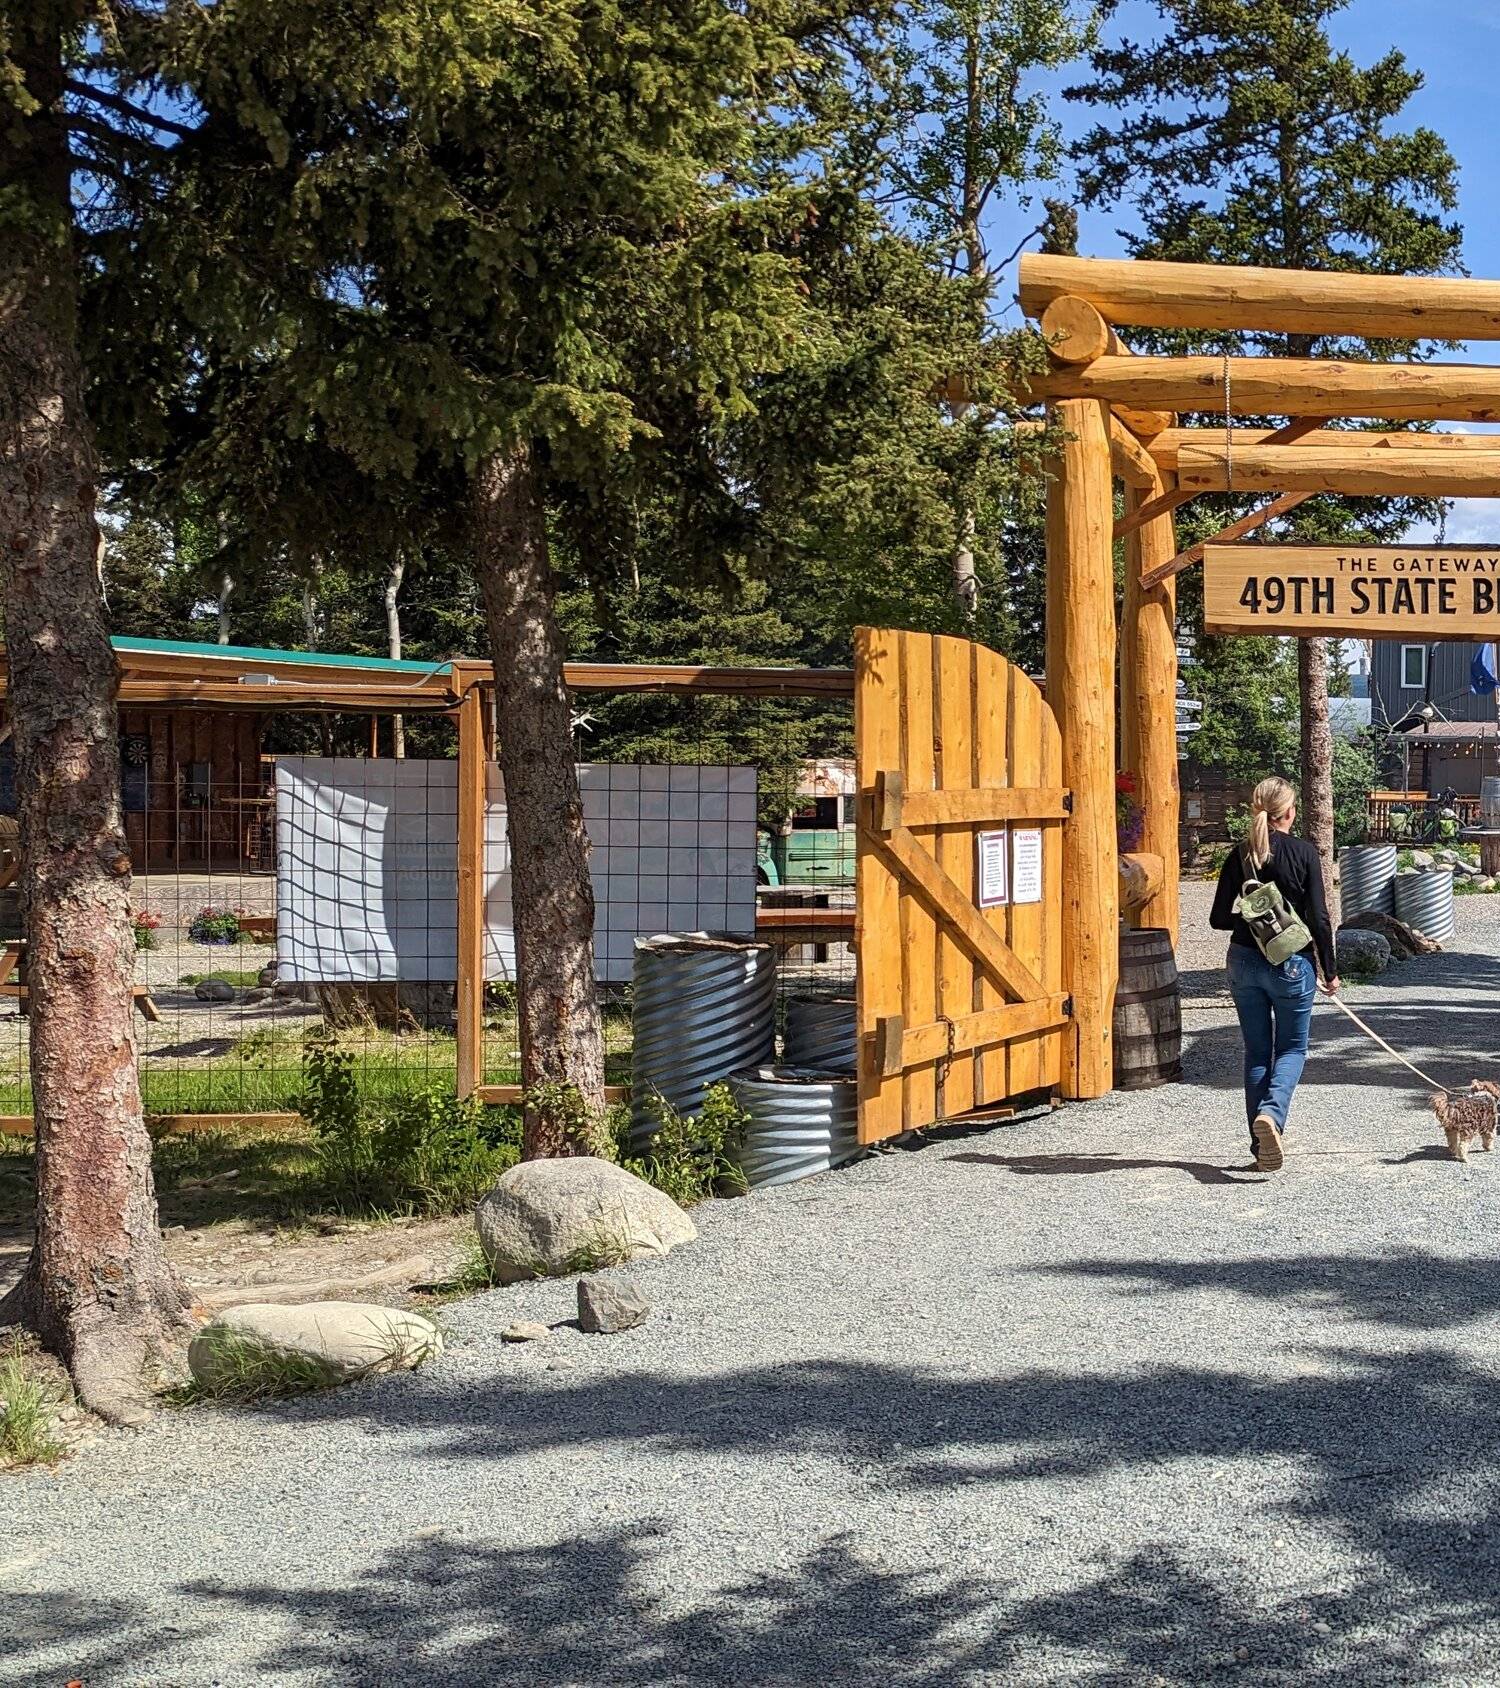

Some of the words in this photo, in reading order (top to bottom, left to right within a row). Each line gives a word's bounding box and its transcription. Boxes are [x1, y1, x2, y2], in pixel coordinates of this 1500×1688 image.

[1336, 557, 1377, 572] THE
[1393, 557, 1499, 572] GATEWAY
[1239, 576, 1335, 614] 49TH
[1350, 577, 1457, 614] STATE
